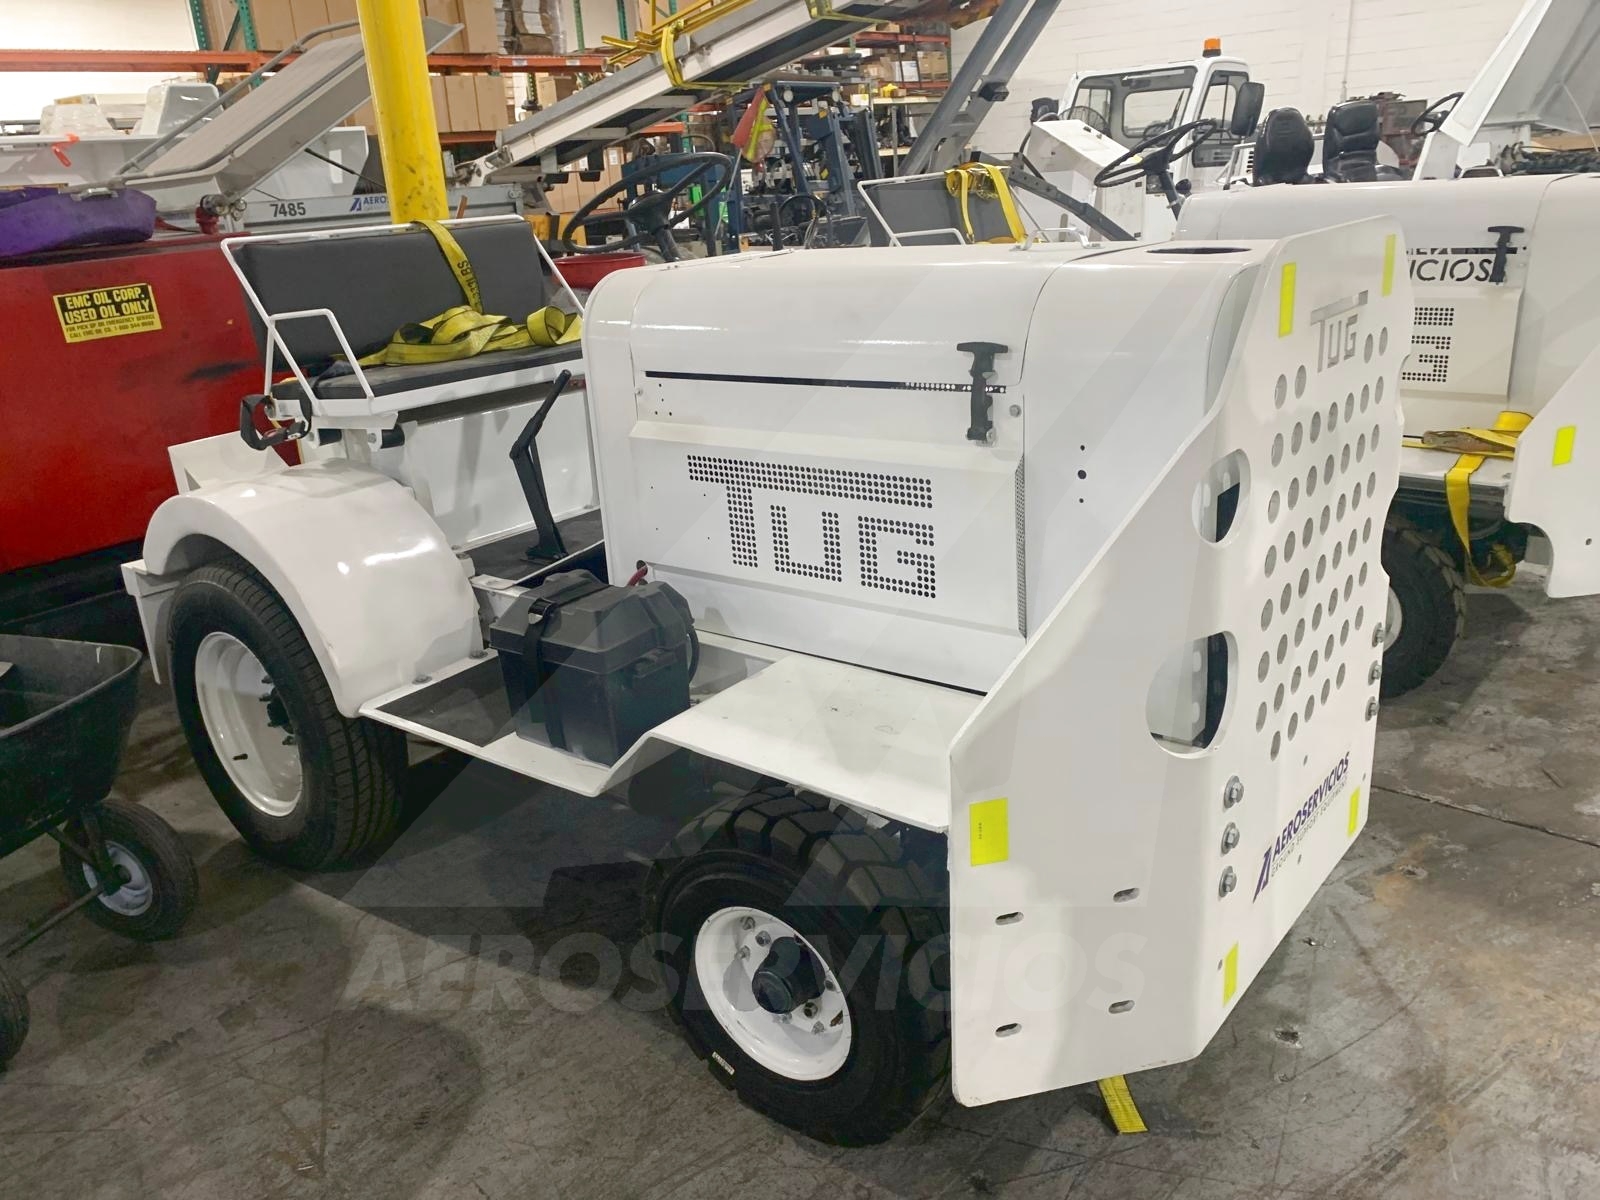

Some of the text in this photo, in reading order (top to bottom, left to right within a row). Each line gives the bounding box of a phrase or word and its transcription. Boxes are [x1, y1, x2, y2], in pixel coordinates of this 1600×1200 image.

[269, 202, 306, 218] 7485
[363, 196, 389, 205] AERO
[1409, 258, 1493, 282] ICIOS
[66, 287, 145, 310] EMC OIL CORP.
[65, 299, 150, 324] USED OIL ONLY
[1310, 289, 1369, 373] TUG
[687, 453, 937, 599] TUG
[1271, 751, 1349, 861] AEROSERVICIOS
